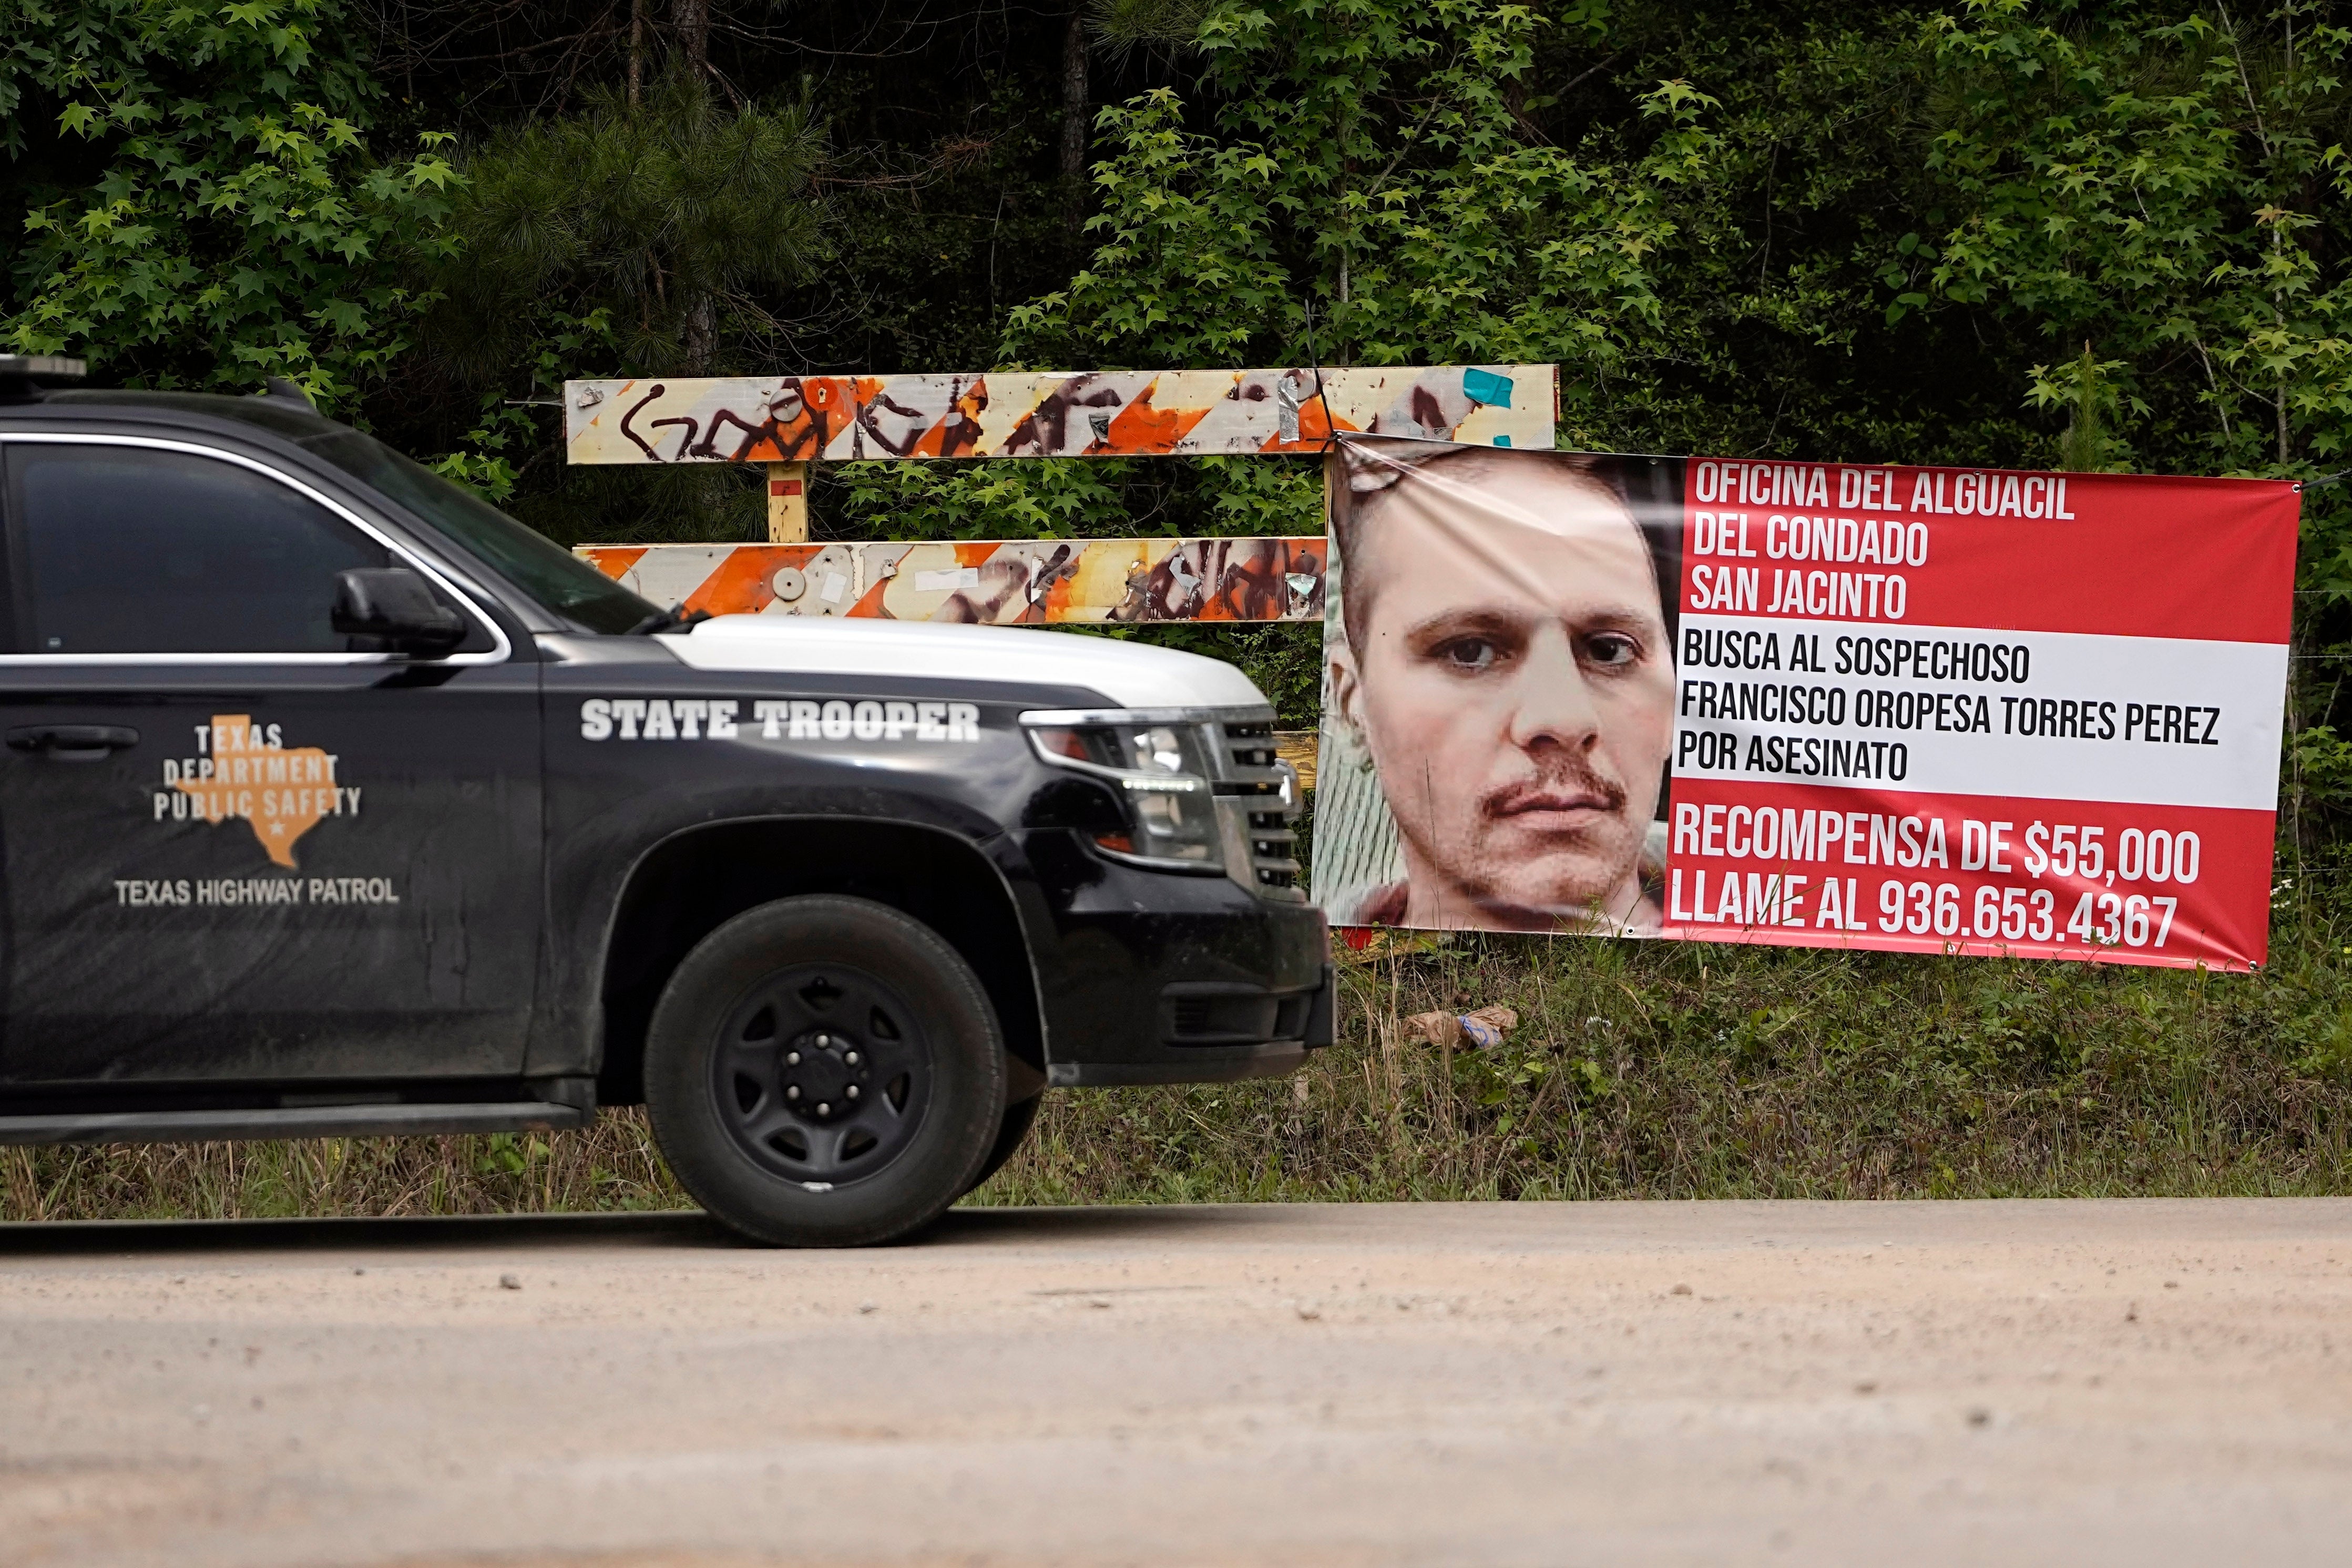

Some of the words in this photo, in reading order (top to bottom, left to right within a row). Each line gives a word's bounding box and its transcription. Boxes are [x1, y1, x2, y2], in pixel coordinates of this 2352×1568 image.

[1696, 461, 1828, 506] OFICINA
[1839, 466, 1900, 513] DEL
[1911, 472, 2074, 520] ALGUACIL
[1694, 511, 1755, 558] DEL
[1767, 515, 1928, 566] CONDADO
[1690, 564, 1758, 611] SAN
[1767, 570, 1907, 620] JACINTO
[1684, 628, 1781, 670] BUSCA
[1789, 635, 1826, 673] AL
[1835, 637, 2030, 684] SOSPECHOSO
[195, 723, 282, 753] TEXAS
[581, 699, 738, 741] STATE
[754, 700, 980, 743] TROOPER
[1682, 680, 1846, 726] FRANCISCO
[1855, 689, 1990, 734] OROPESA
[2001, 697, 2115, 739] TORRES
[2125, 704, 2220, 745] PEREZ
[163, 754, 339, 787] DEPARTMENT
[1679, 731, 1736, 771] POR
[1745, 735, 1907, 781] ASESINATO
[153, 790, 253, 820] PUBLIC
[263, 787, 362, 818] SAFETY
[1673, 802, 1948, 869] RECOMPENSA
[1961, 820, 2011, 873] DE
[2023, 821, 2200, 887] $55,000
[114, 879, 191, 906] TEXAS
[197, 878, 303, 905] HIGHWAY
[309, 877, 399, 903] PATROL
[1670, 869, 1806, 925] LLAME
[1817, 877, 1867, 930] AL
[1878, 882, 2177, 948] 936.653.4367
